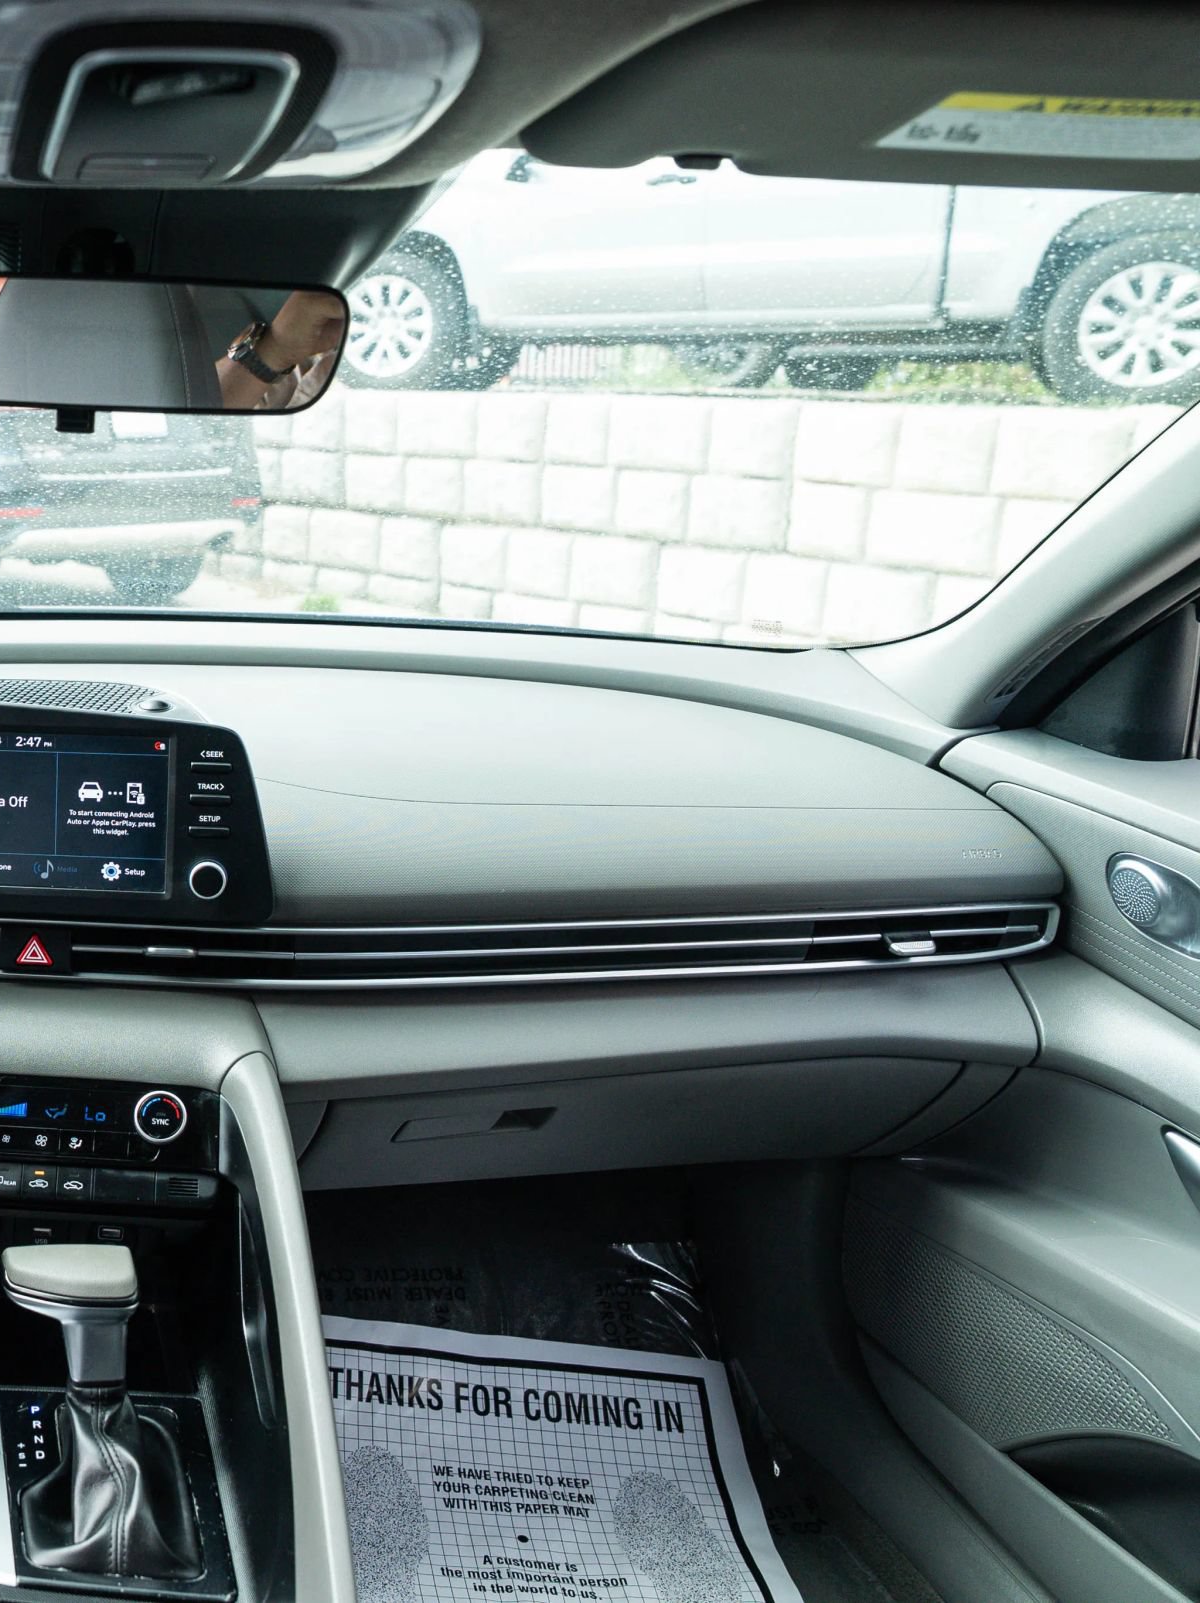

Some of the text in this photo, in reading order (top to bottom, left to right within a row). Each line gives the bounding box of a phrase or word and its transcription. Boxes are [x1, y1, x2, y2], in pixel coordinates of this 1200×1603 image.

[15, 736, 42, 747] 2:47
[8, 795, 29, 808] Off
[199, 815, 221, 823] SETUP
[124, 868, 146, 876] Setup
[151, 1117, 170, 1126] SYNC
[329, 1367, 684, 1434] THANKS FOR COMING IN
[31, 1406, 40, 1414] P
[32, 1420, 42, 1429] R
[34, 1435, 44, 1444] N
[35, 1450, 46, 1459] D
[433, 1465, 590, 1489] WE HAVE TRIED TO KEEP
[433, 1481, 595, 1505] YOUR CARPETING CLEAN
[443, 1498, 590, 1518] WITH THIS PAPER MAT
[483, 1555, 578, 1573] A customer is
[440, 1566, 628, 1588] the most important person
[473, 1582, 603, 1600] in the world to us.
